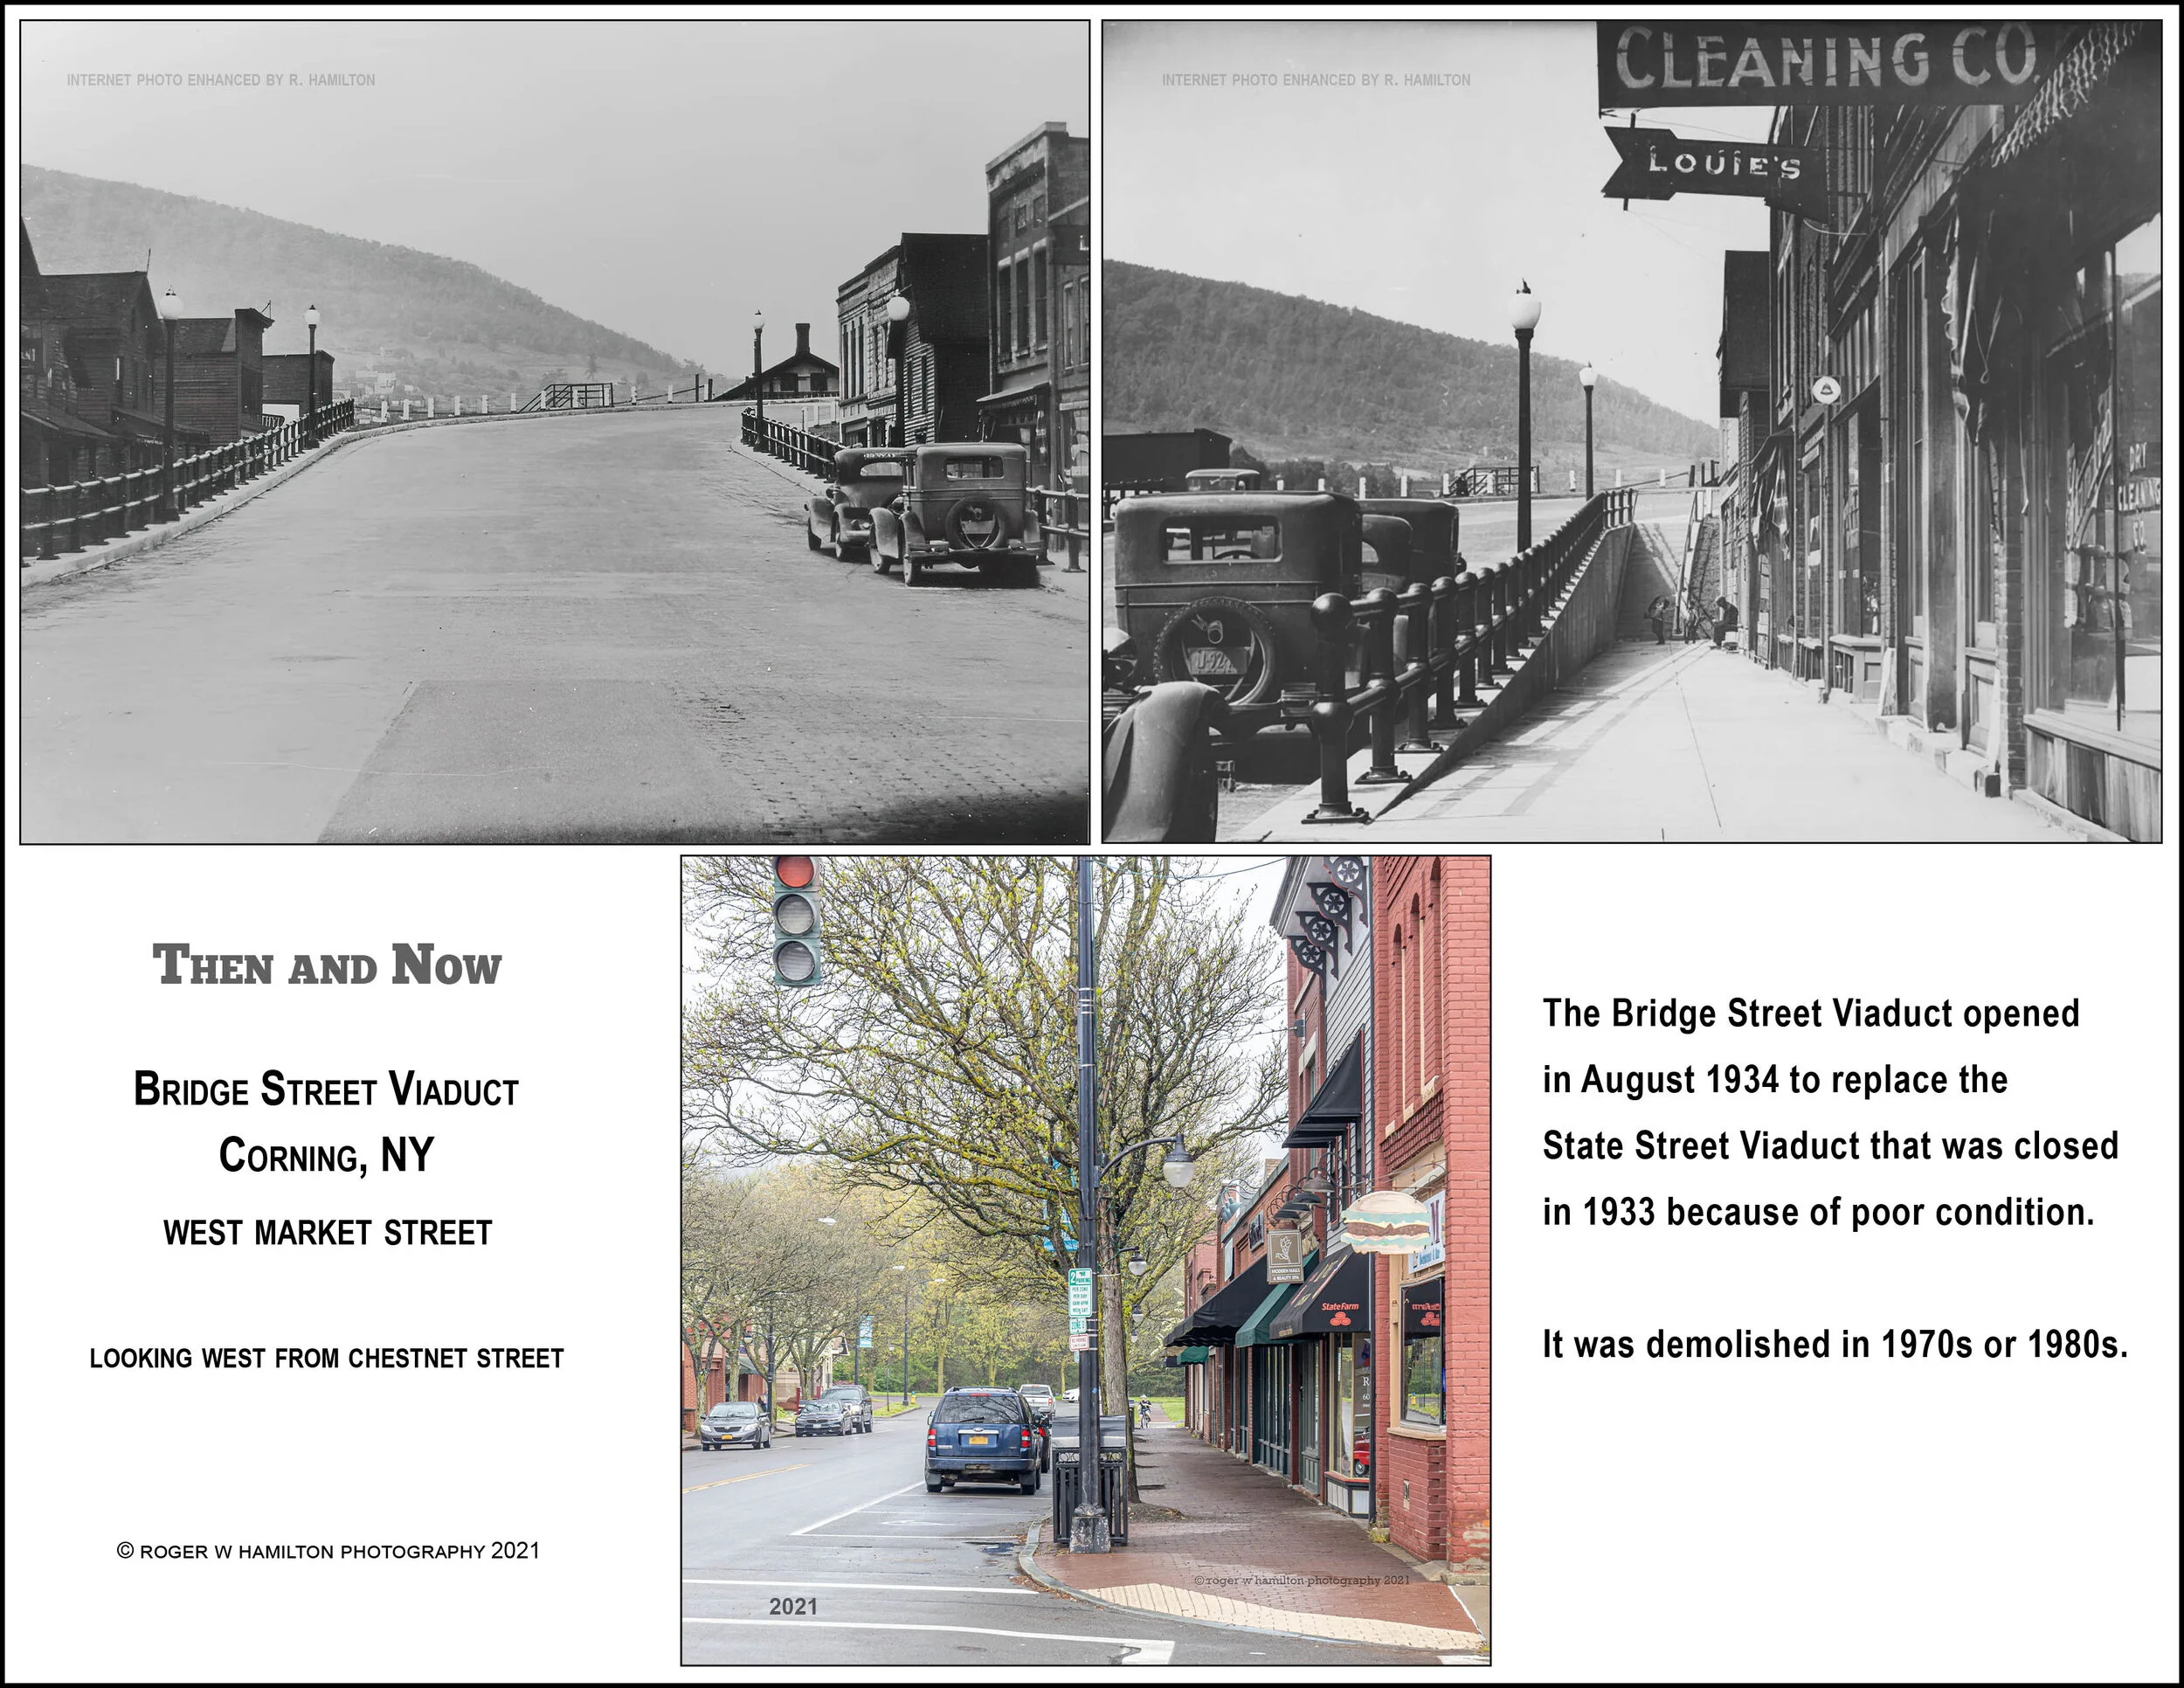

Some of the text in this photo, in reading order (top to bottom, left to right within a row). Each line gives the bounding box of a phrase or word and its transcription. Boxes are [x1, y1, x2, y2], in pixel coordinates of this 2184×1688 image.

[1616, 26, 1930, 89] CLEANING
[1648, 145, 1801, 180] LOUIE'S
[1070, 1272, 1076, 1283] 2
[1072, 1321, 1081, 1330] ZONE
